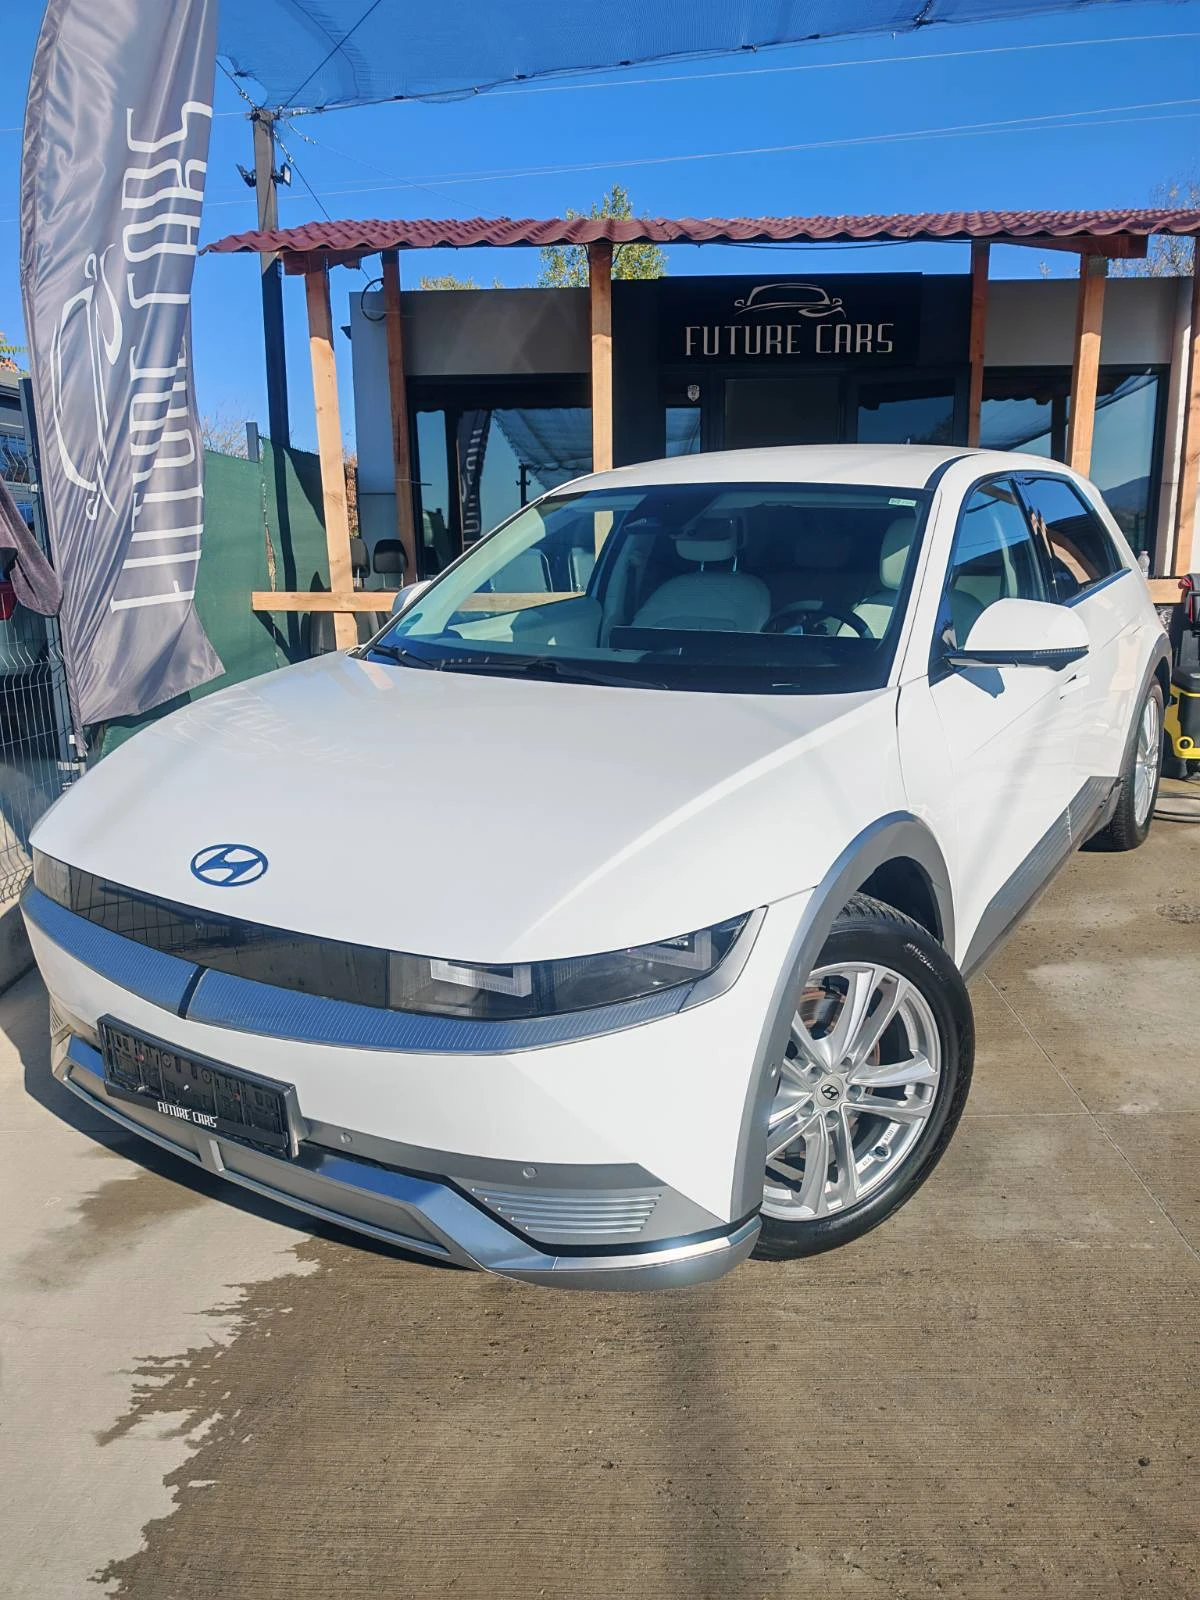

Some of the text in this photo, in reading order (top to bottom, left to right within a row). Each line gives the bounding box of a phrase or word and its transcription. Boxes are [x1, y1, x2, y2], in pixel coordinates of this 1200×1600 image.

[685, 323, 894, 356] FUTURE CARS
[158, 1101, 218, 1128] FUTURE CARS
